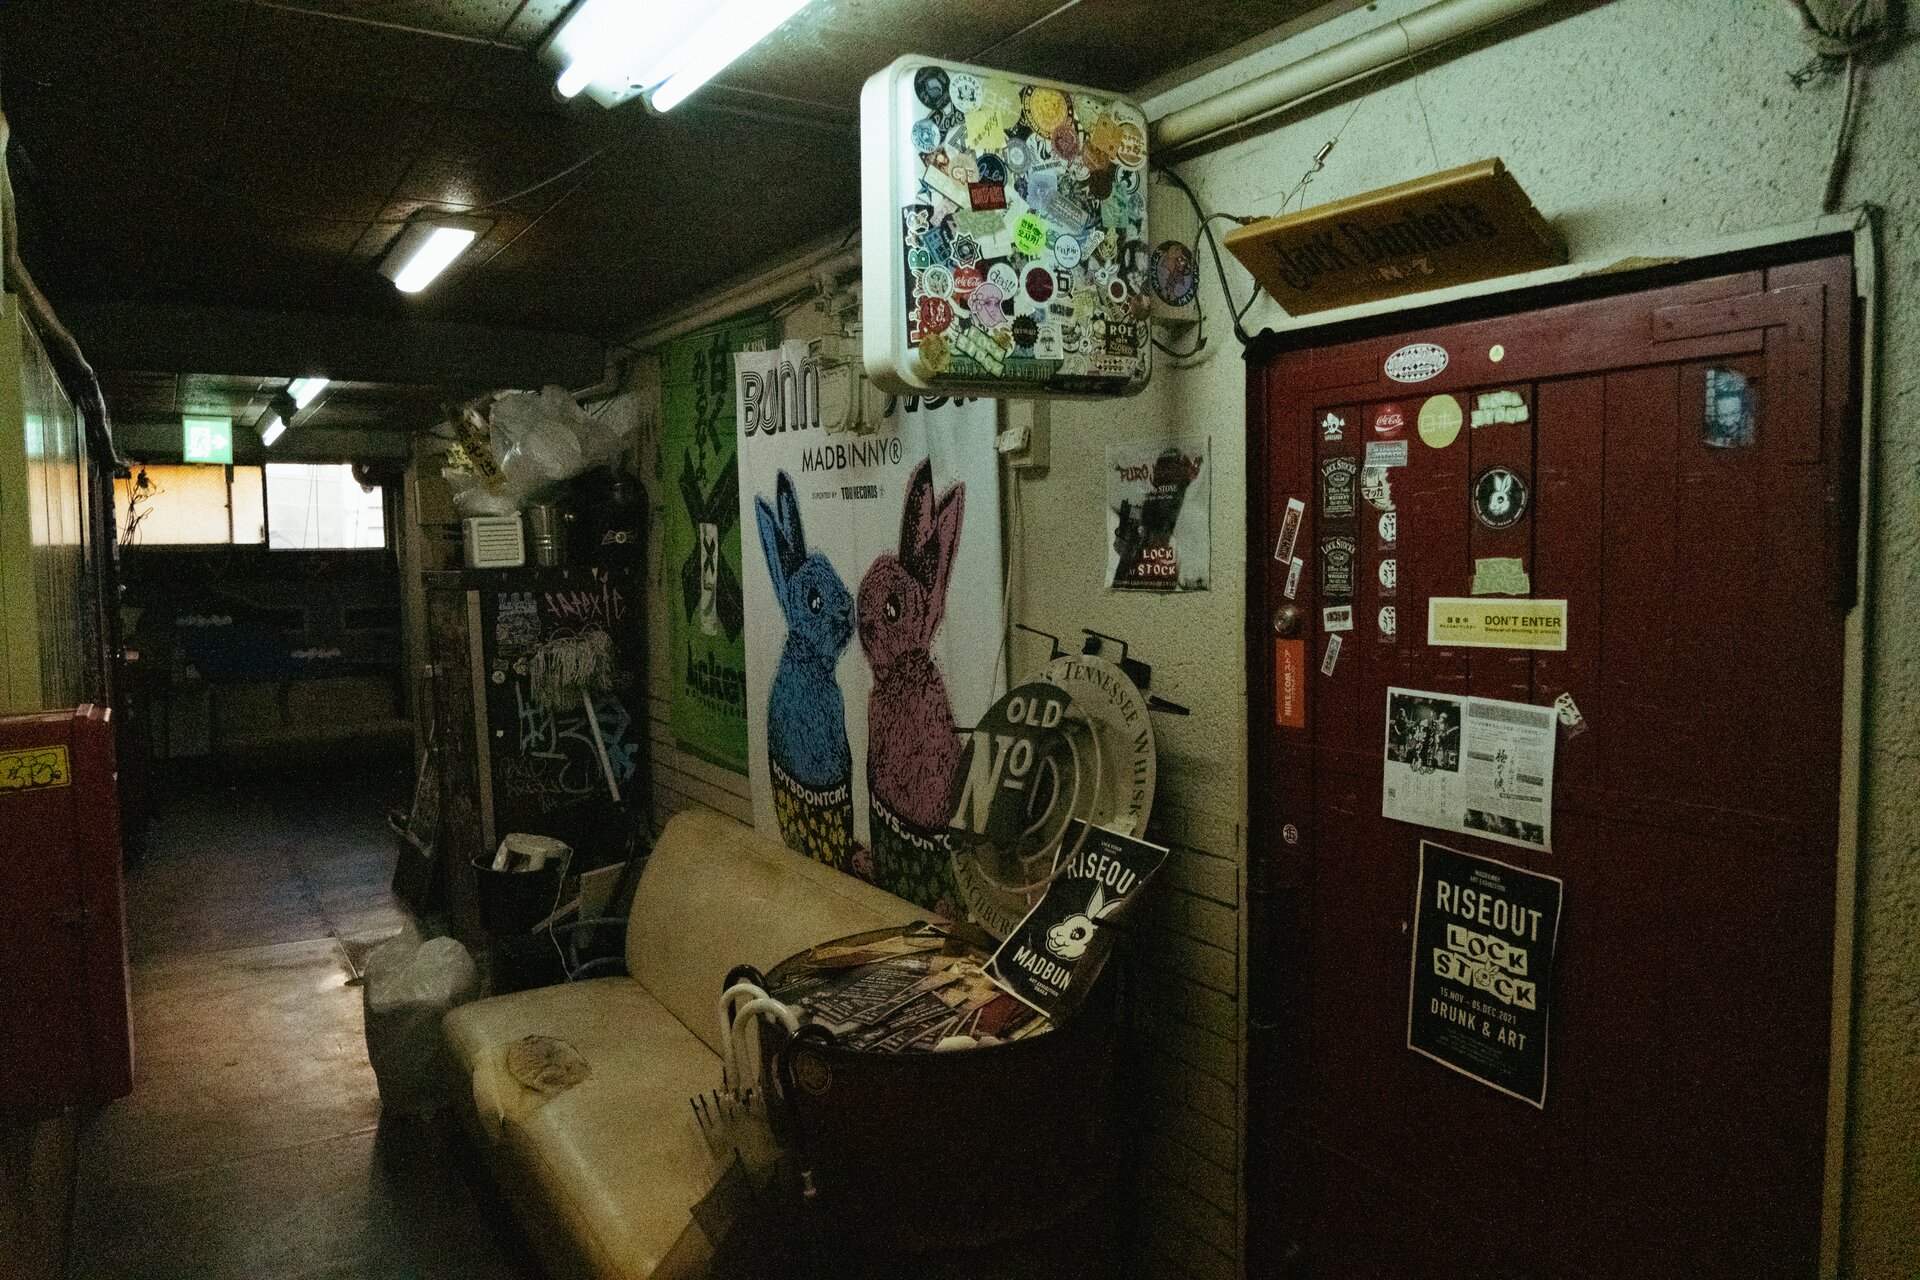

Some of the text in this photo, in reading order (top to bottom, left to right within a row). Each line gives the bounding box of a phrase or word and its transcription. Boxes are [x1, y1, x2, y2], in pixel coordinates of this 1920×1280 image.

[1138, 563, 1175, 576] STOCK
[1143, 548, 1173, 561] LOCK
[1485, 616, 1561, 628] DON'T ENTER
[1064, 661, 1140, 727] TENNESSEE
[1007, 697, 1060, 728] OLD
[1436, 879, 1543, 942] RISEOUT
[1450, 929, 1525, 969] LOCK
[1430, 997, 1527, 1051] DRUNK & ART
